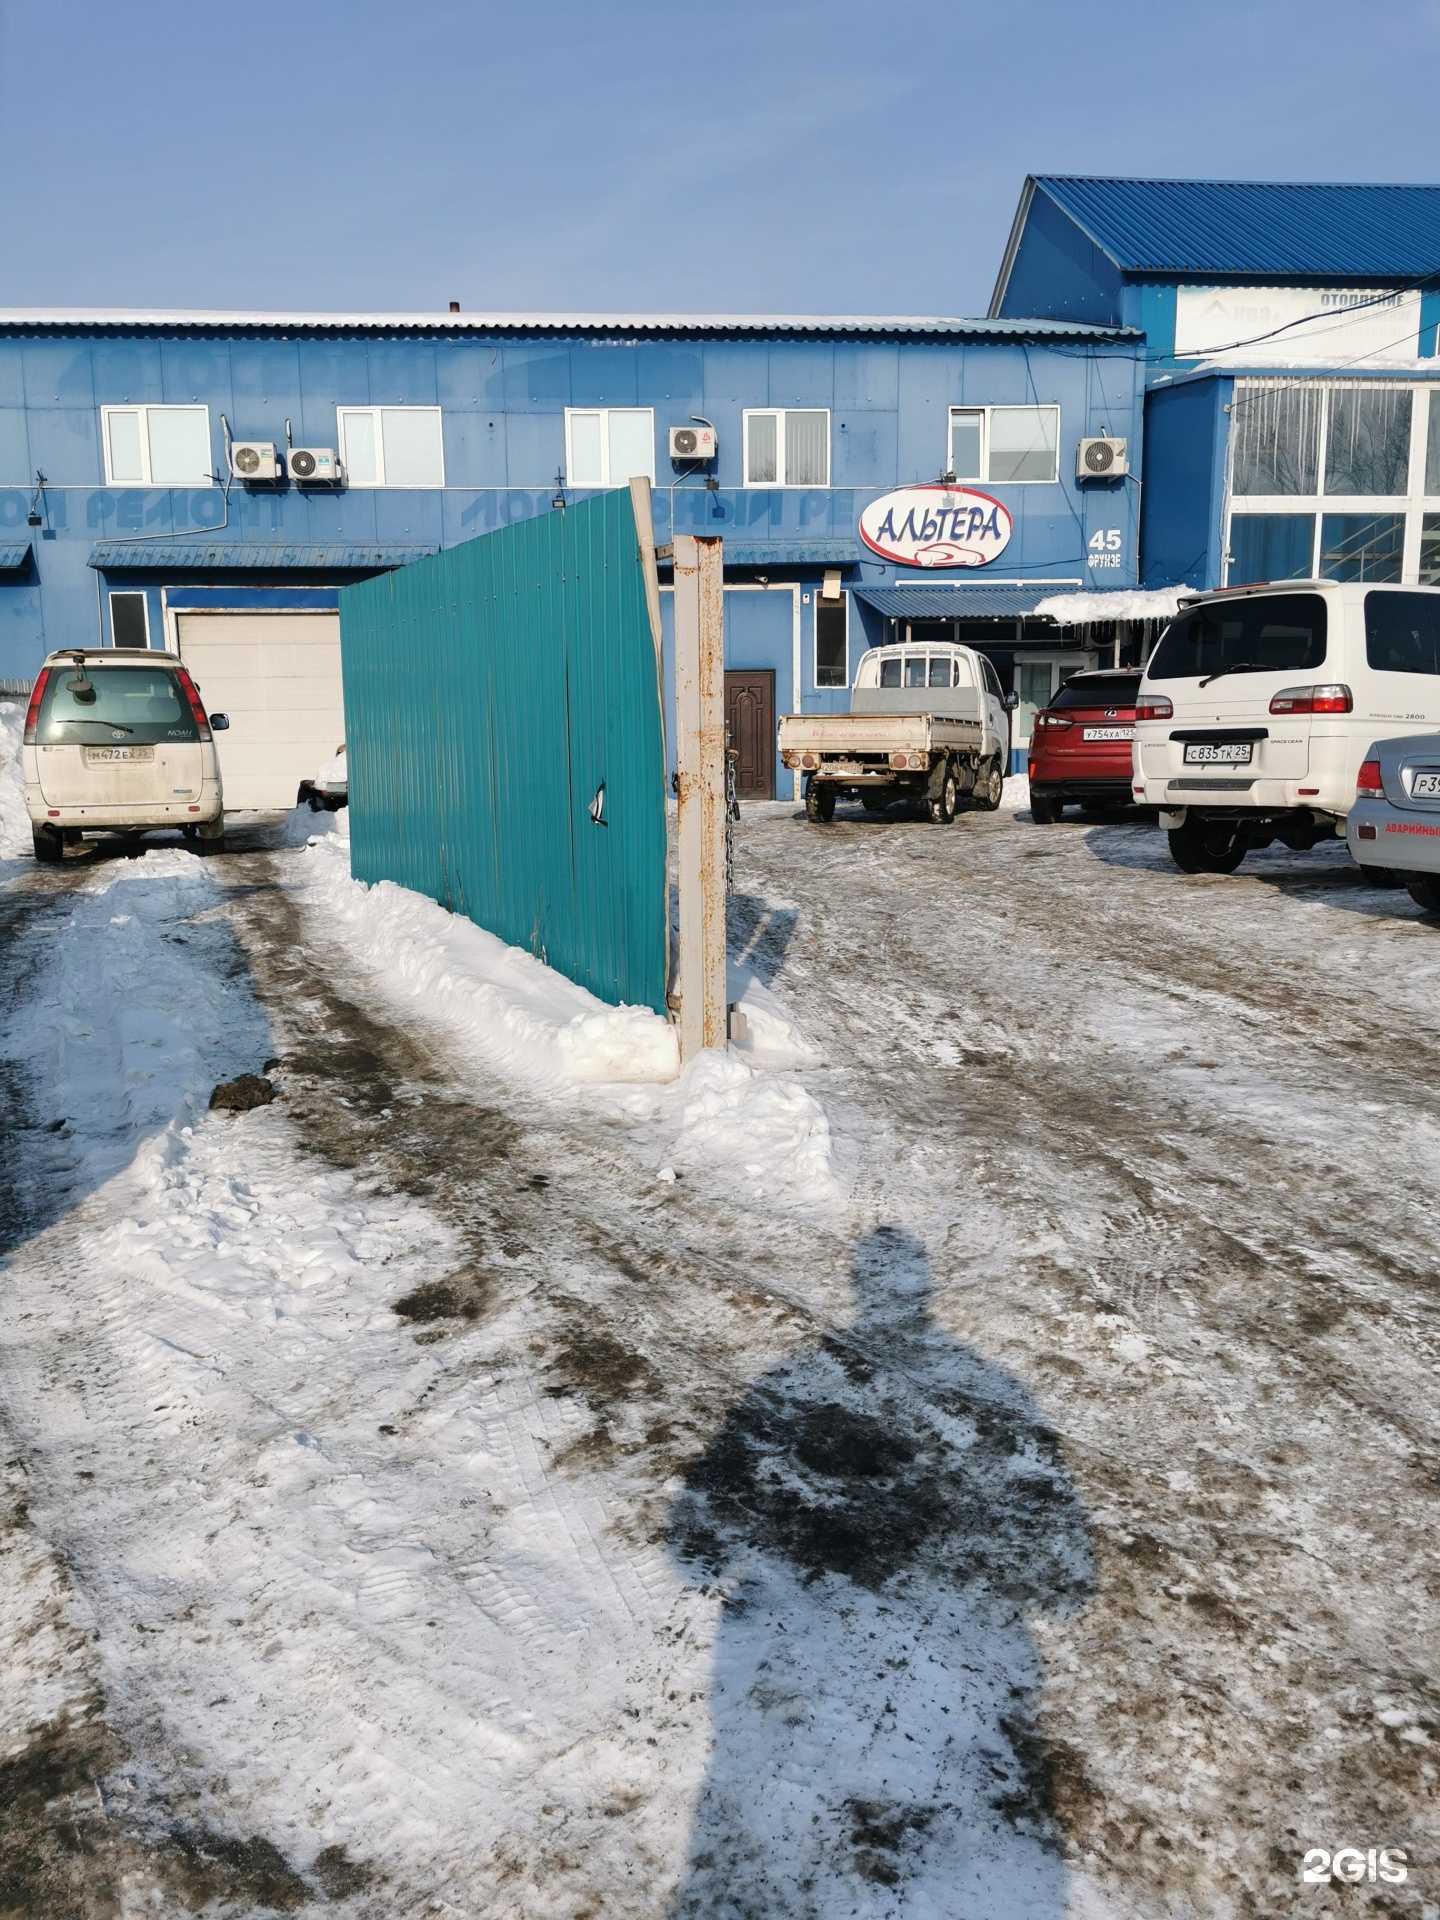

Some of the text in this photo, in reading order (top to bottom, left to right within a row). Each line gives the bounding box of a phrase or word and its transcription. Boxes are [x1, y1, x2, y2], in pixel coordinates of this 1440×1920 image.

[876, 506, 1002, 542] АЛЬТЕРА
[1088, 529, 1121, 550] 45
[1087, 553, 1121, 568] ФРУНЗЕ
